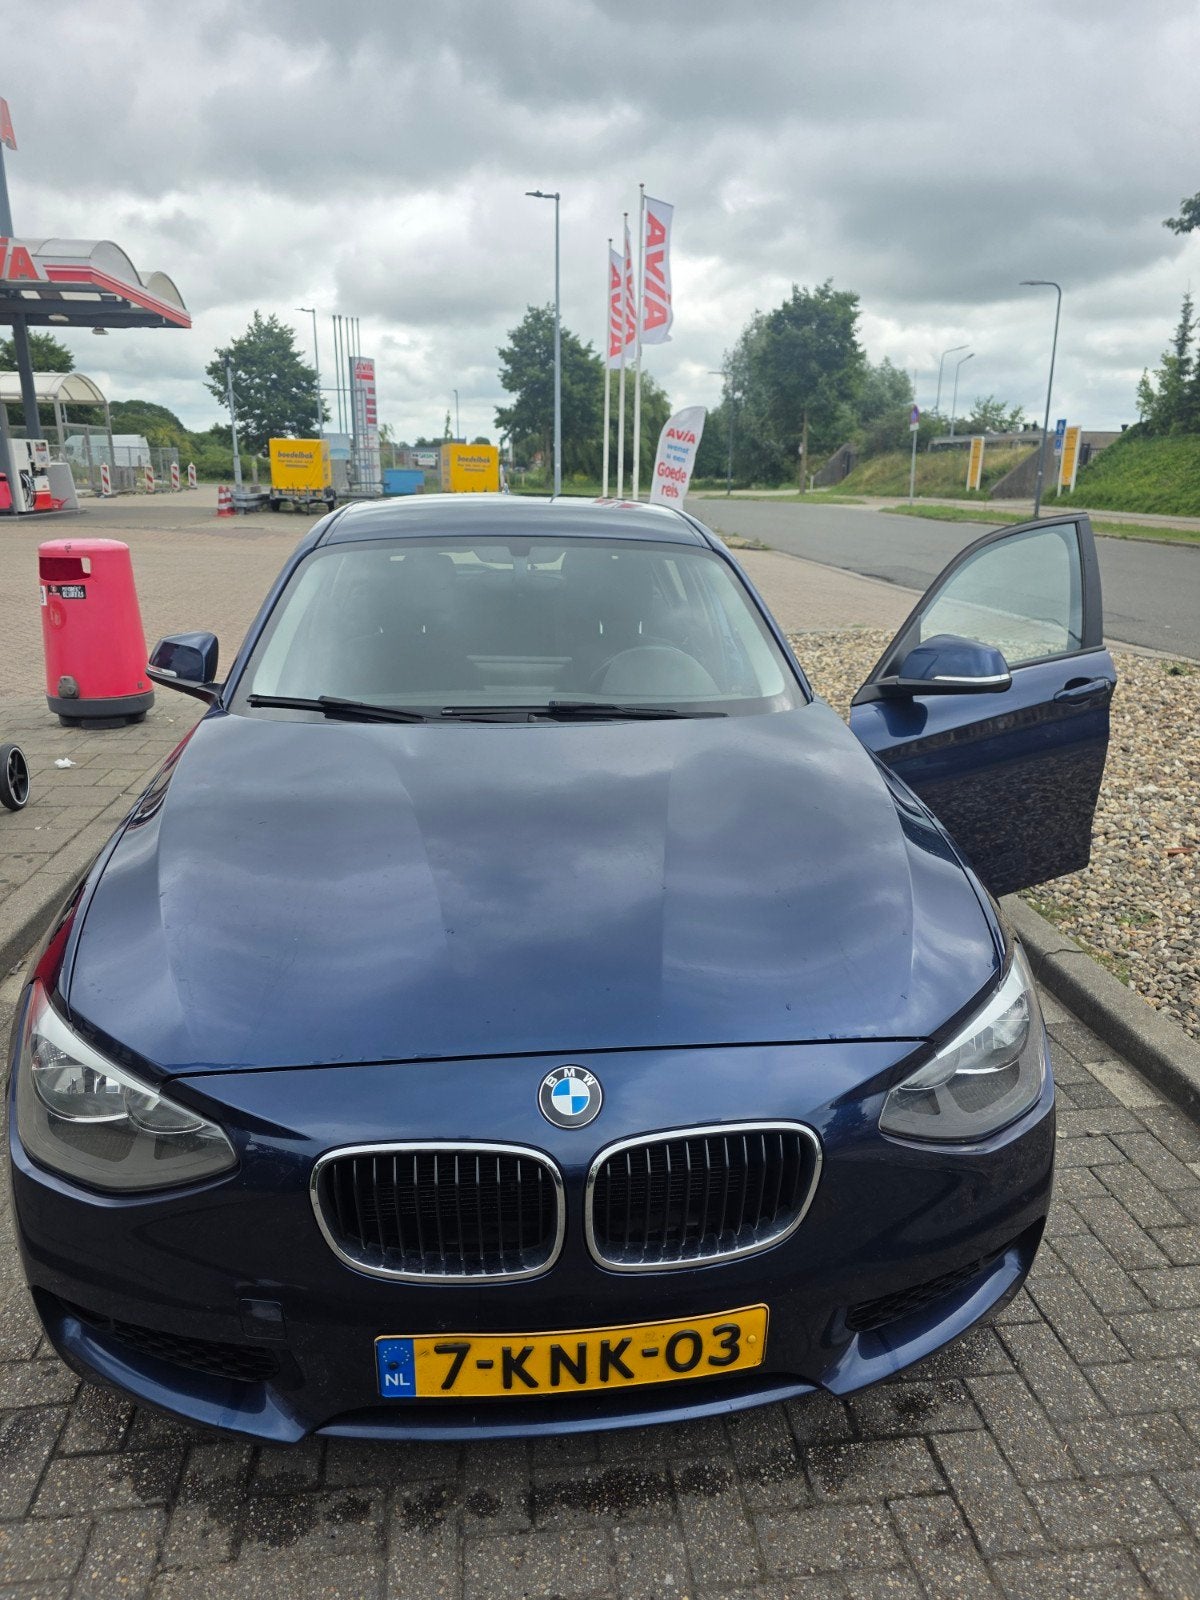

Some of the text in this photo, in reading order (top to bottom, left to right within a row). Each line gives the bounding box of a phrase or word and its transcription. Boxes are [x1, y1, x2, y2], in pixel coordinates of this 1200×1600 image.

[644, 211, 672, 332] AVIA
[610, 262, 623, 357] AVIA
[666, 428, 696, 444] AVIA
[667, 444, 690, 455] wenst
[673, 455, 686, 463] een
[657, 462, 687, 483] Goede
[661, 483, 679, 498] reis
[545, 1067, 595, 1088] BMW
[434, 1323, 741, 1390] 7-KNK-03
[385, 1373, 410, 1387] NL
